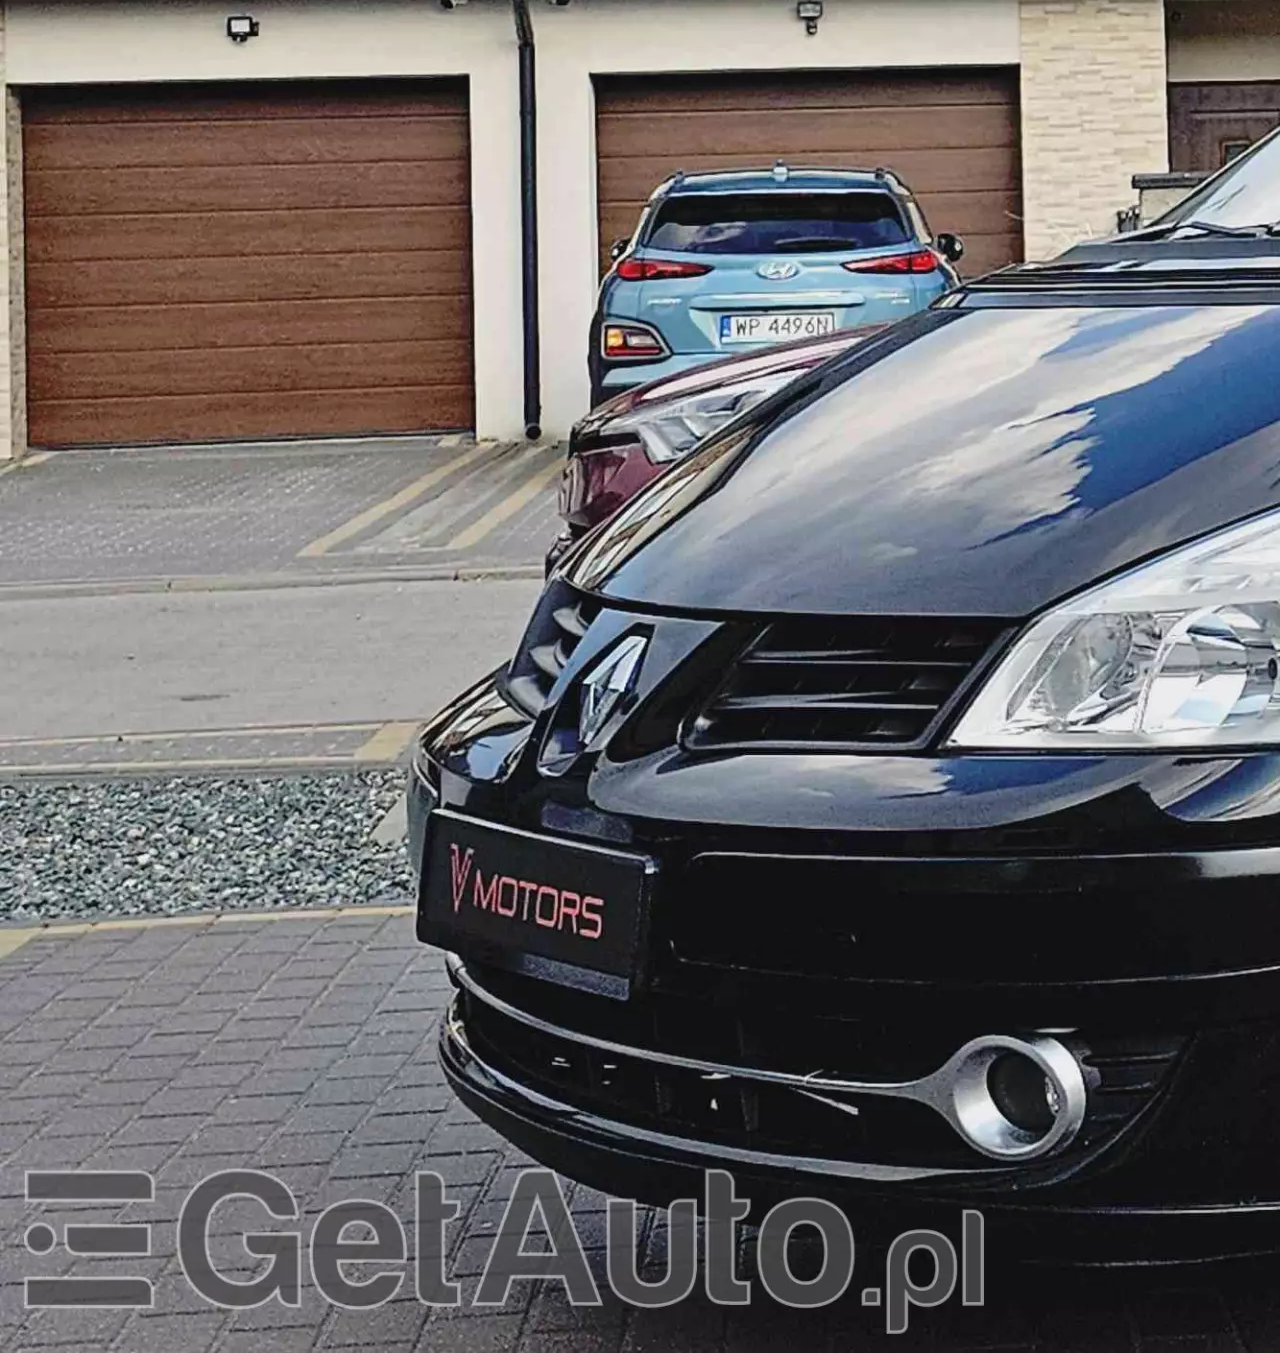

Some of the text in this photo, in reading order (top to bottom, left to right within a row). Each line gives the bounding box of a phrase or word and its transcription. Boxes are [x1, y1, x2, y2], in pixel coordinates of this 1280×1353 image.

[735, 316, 828, 336] WP 4496N
[473, 869, 604, 940] MOTORS
